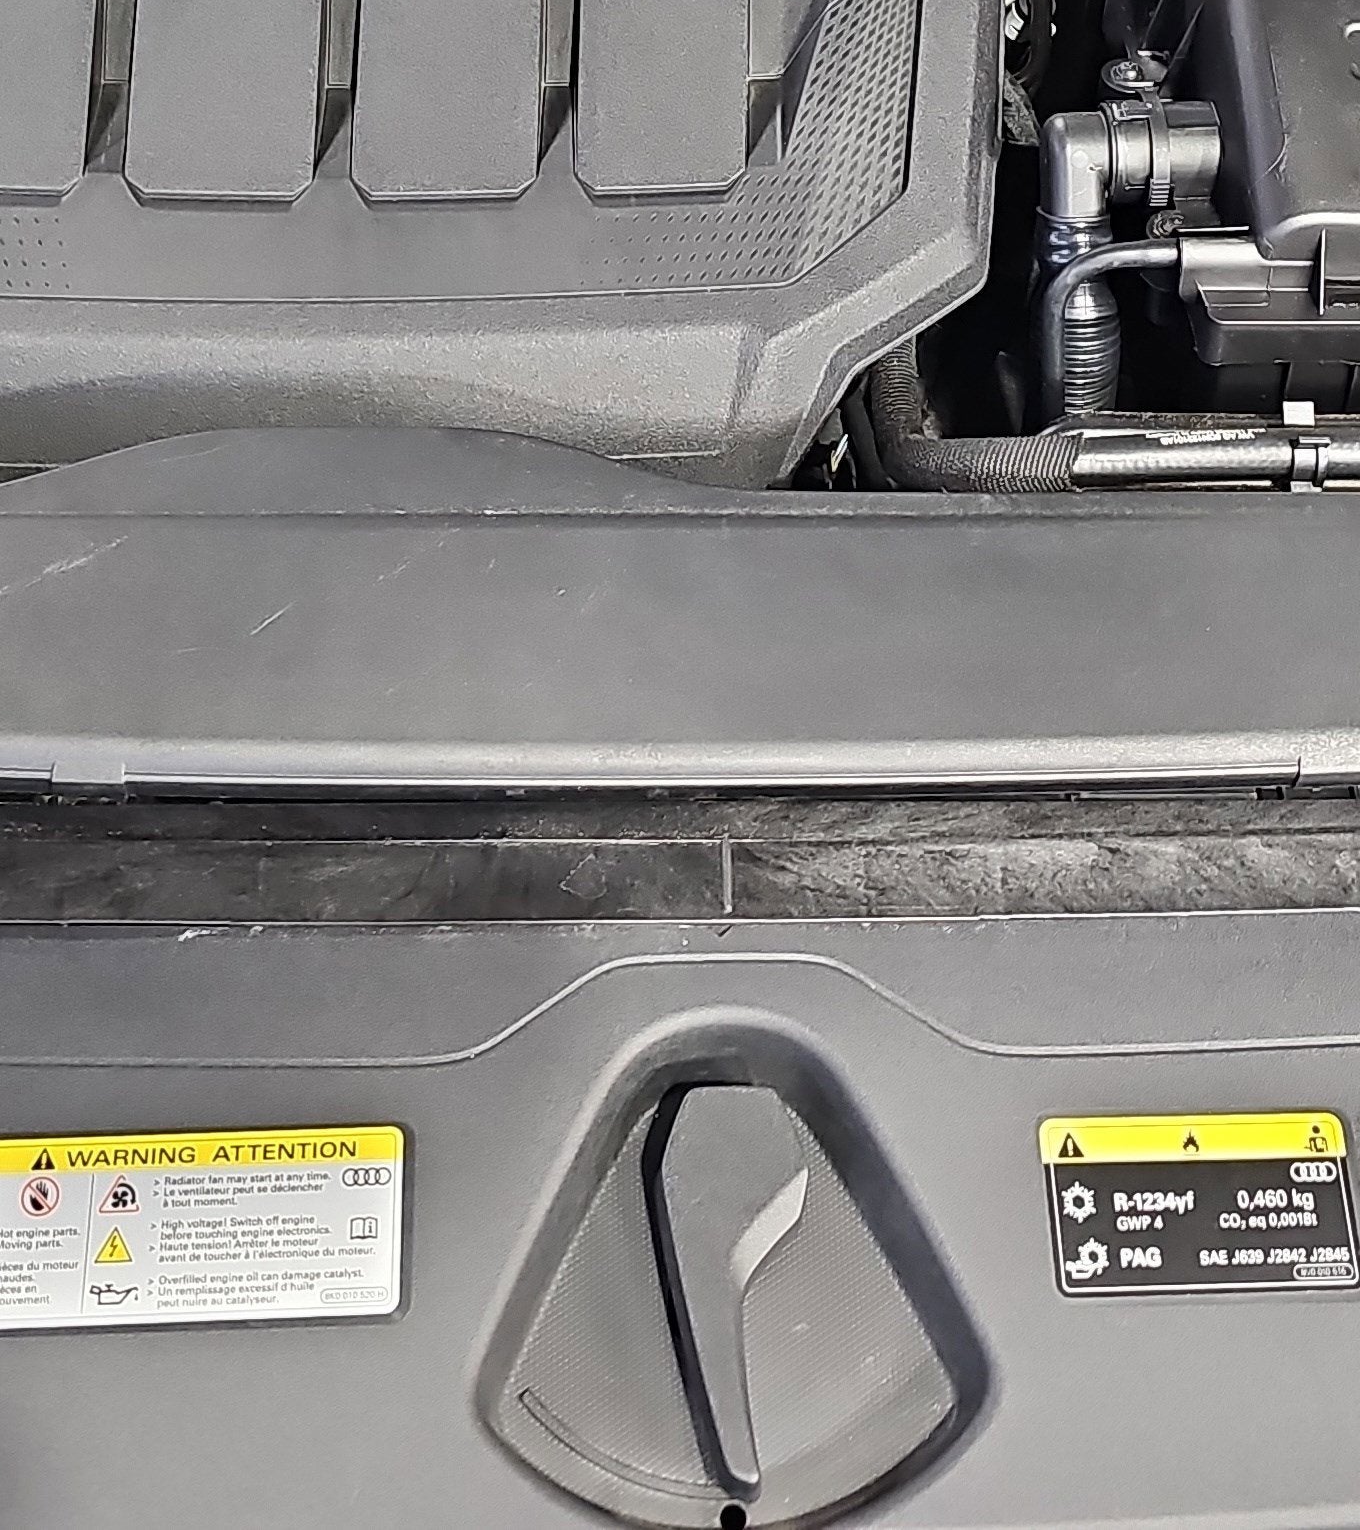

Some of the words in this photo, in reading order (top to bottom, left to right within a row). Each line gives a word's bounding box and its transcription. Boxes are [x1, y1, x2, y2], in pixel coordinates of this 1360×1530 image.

[67, 1146, 195, 1167] WARNING
[212, 1141, 356, 1162] ATTENTION
[164, 1175, 206, 1185] Radiator
[208, 1174, 224, 1184] fan
[227, 1174, 248, 1185] may
[250, 1173, 272, 1183] start
[274, 1173, 284, 1182] at
[286, 1173, 305, 1183] any
[307, 1171, 331, 1181] time.
[163, 1187, 175, 1197] Le
[178, 1185, 231, 1196] ventilateur
[233, 1184, 255, 1196] peut
[257, 1185, 268, 1193] se
[270, 1183, 324, 1193] déclencher
[163, 1198, 169, 1208] à
[171, 1199, 191, 1208] tout
[194, 1197, 238, 1207] moment.
[1113, 1190, 1195, 1215] R-1234yf
[1236, 1188, 1288, 1211] 0,460
[1292, 1188, 1315, 1211] kg
[161, 1219, 185, 1230] High
[187, 1218, 227, 1230] voltage!
[230, 1216, 263, 1227] Switch
[266, 1215, 279, 1226] off
[281, 1215, 315, 1226] engine
[1116, 1215, 1151, 1231] GWP
[1153, 1215, 1164, 1230] 4
[1248, 1215, 1268, 1230] eq
[16, 1228, 50, 1240] engine
[52, 1227, 81, 1239] parts.
[160, 1230, 192, 1240] before
[195, 1228, 238, 1240] touching
[241, 1227, 275, 1239] engine
[277, 1225, 332, 1236] electronics.
[35, 1239, 64, 1250] parts.
[160, 1242, 189, 1251] Haute
[191, 1240, 232, 1250] tension!
[234, 1239, 268, 1249] Arrêter
[271, 1238, 280, 1247] le
[282, 1238, 319, 1247] moteur
[159, 1253, 186, 1263] avant
[189, 1252, 201, 1261] de
[204, 1250, 242, 1261] toucher
[244, 1250, 250, 1260] à
[322, 1247, 335, 1256] du
[337, 1247, 376, 1256] moteur.
[1119, 1246, 1162, 1268] PAG
[1199, 1249, 1229, 1266] SAE
[1231, 1248, 1265, 1266] J639
[1267, 1246, 1307, 1265] J2842
[1309, 1245, 1350, 1263] J2845
[26, 1261, 40, 1270] du
[43, 1261, 79, 1270] moteur
[158, 1274, 207, 1285] Overfilled
[210, 1273, 243, 1284] engine
[246, 1271, 259, 1282] oil
[261, 1273, 279, 1281] can
[281, 1271, 321, 1281] damage
[24, 1285, 37, 1294] en
[158, 1287, 173, 1296] Un
[175, 1284, 236, 1296] remplissage
[239, 1282, 279, 1293] excessif
[377, 1290, 384, 1298] H
[157, 1298, 179, 1309] peut
[182, 1296, 208, 1306] nuire
[211, 1298, 223, 1306] au
[226, 1295, 280, 1306] catalyseur.
